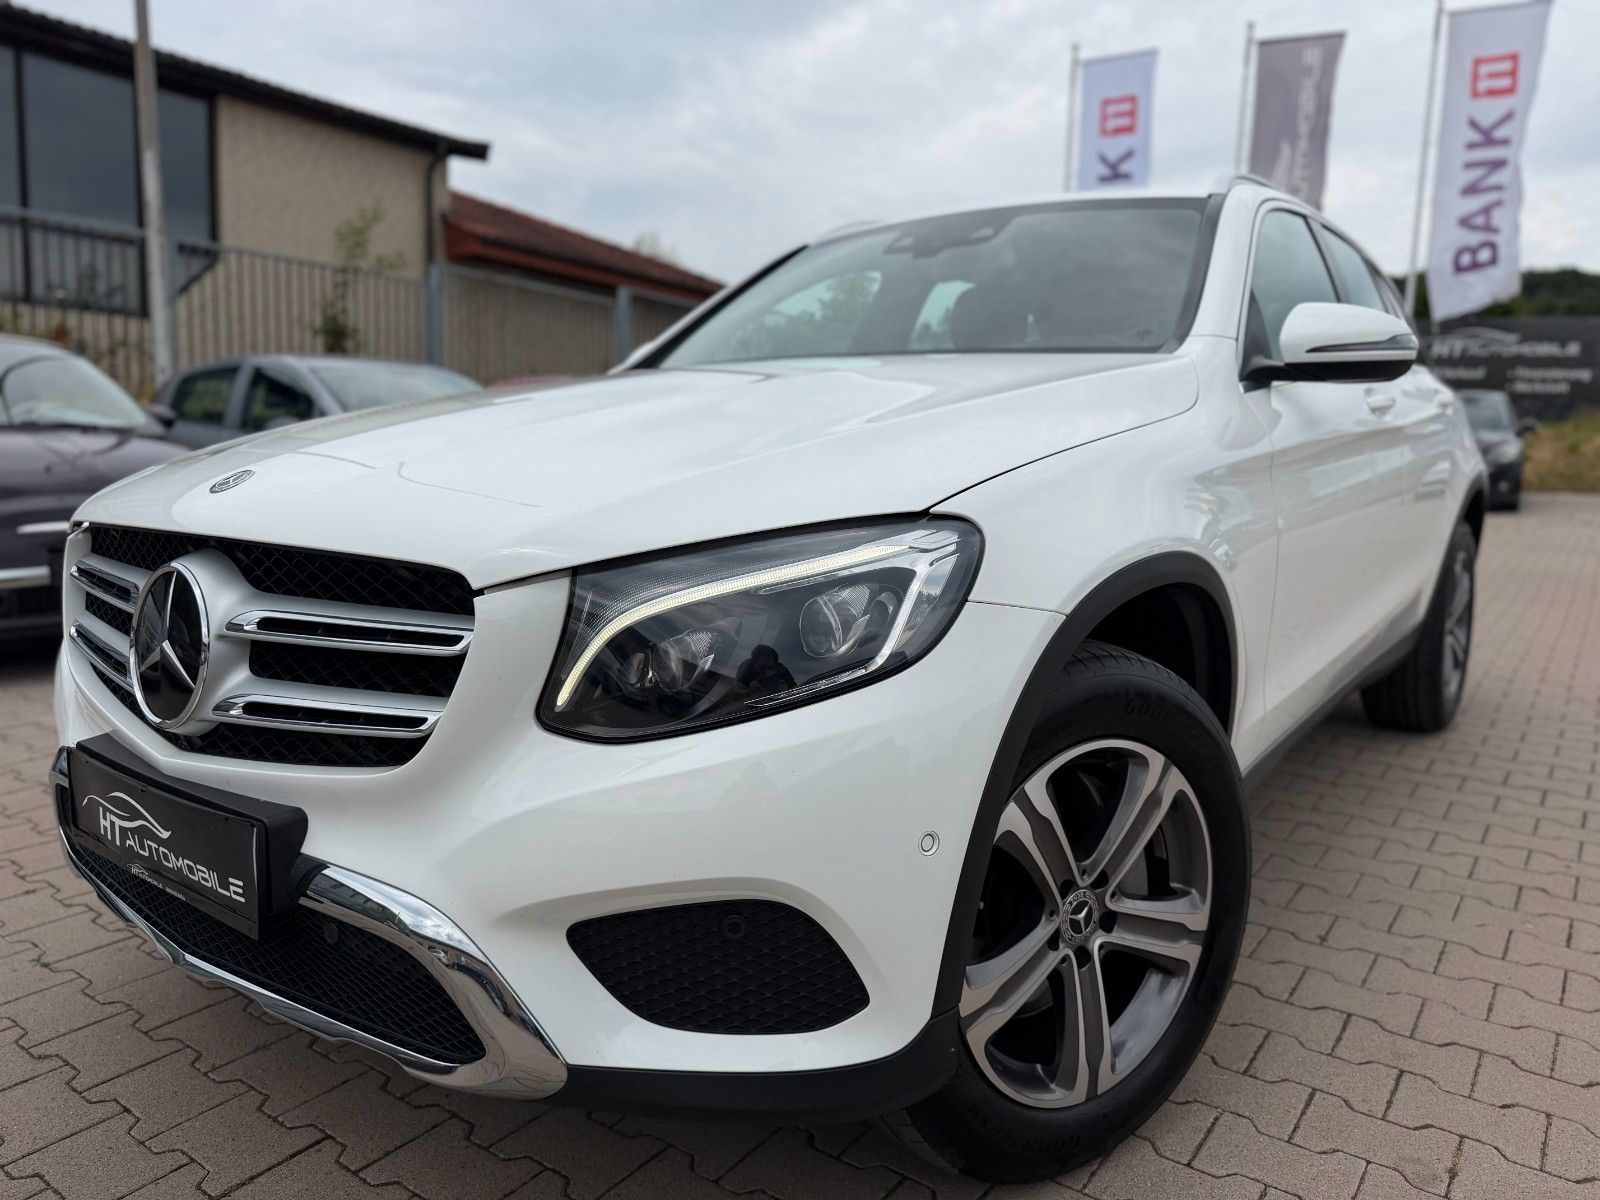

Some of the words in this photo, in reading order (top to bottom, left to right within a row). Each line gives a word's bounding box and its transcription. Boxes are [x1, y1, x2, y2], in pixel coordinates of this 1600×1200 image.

[1454, 109, 1515, 275] BANK
[99, 806, 125, 847] HT
[126, 831, 246, 903] AUTOMOBILE
